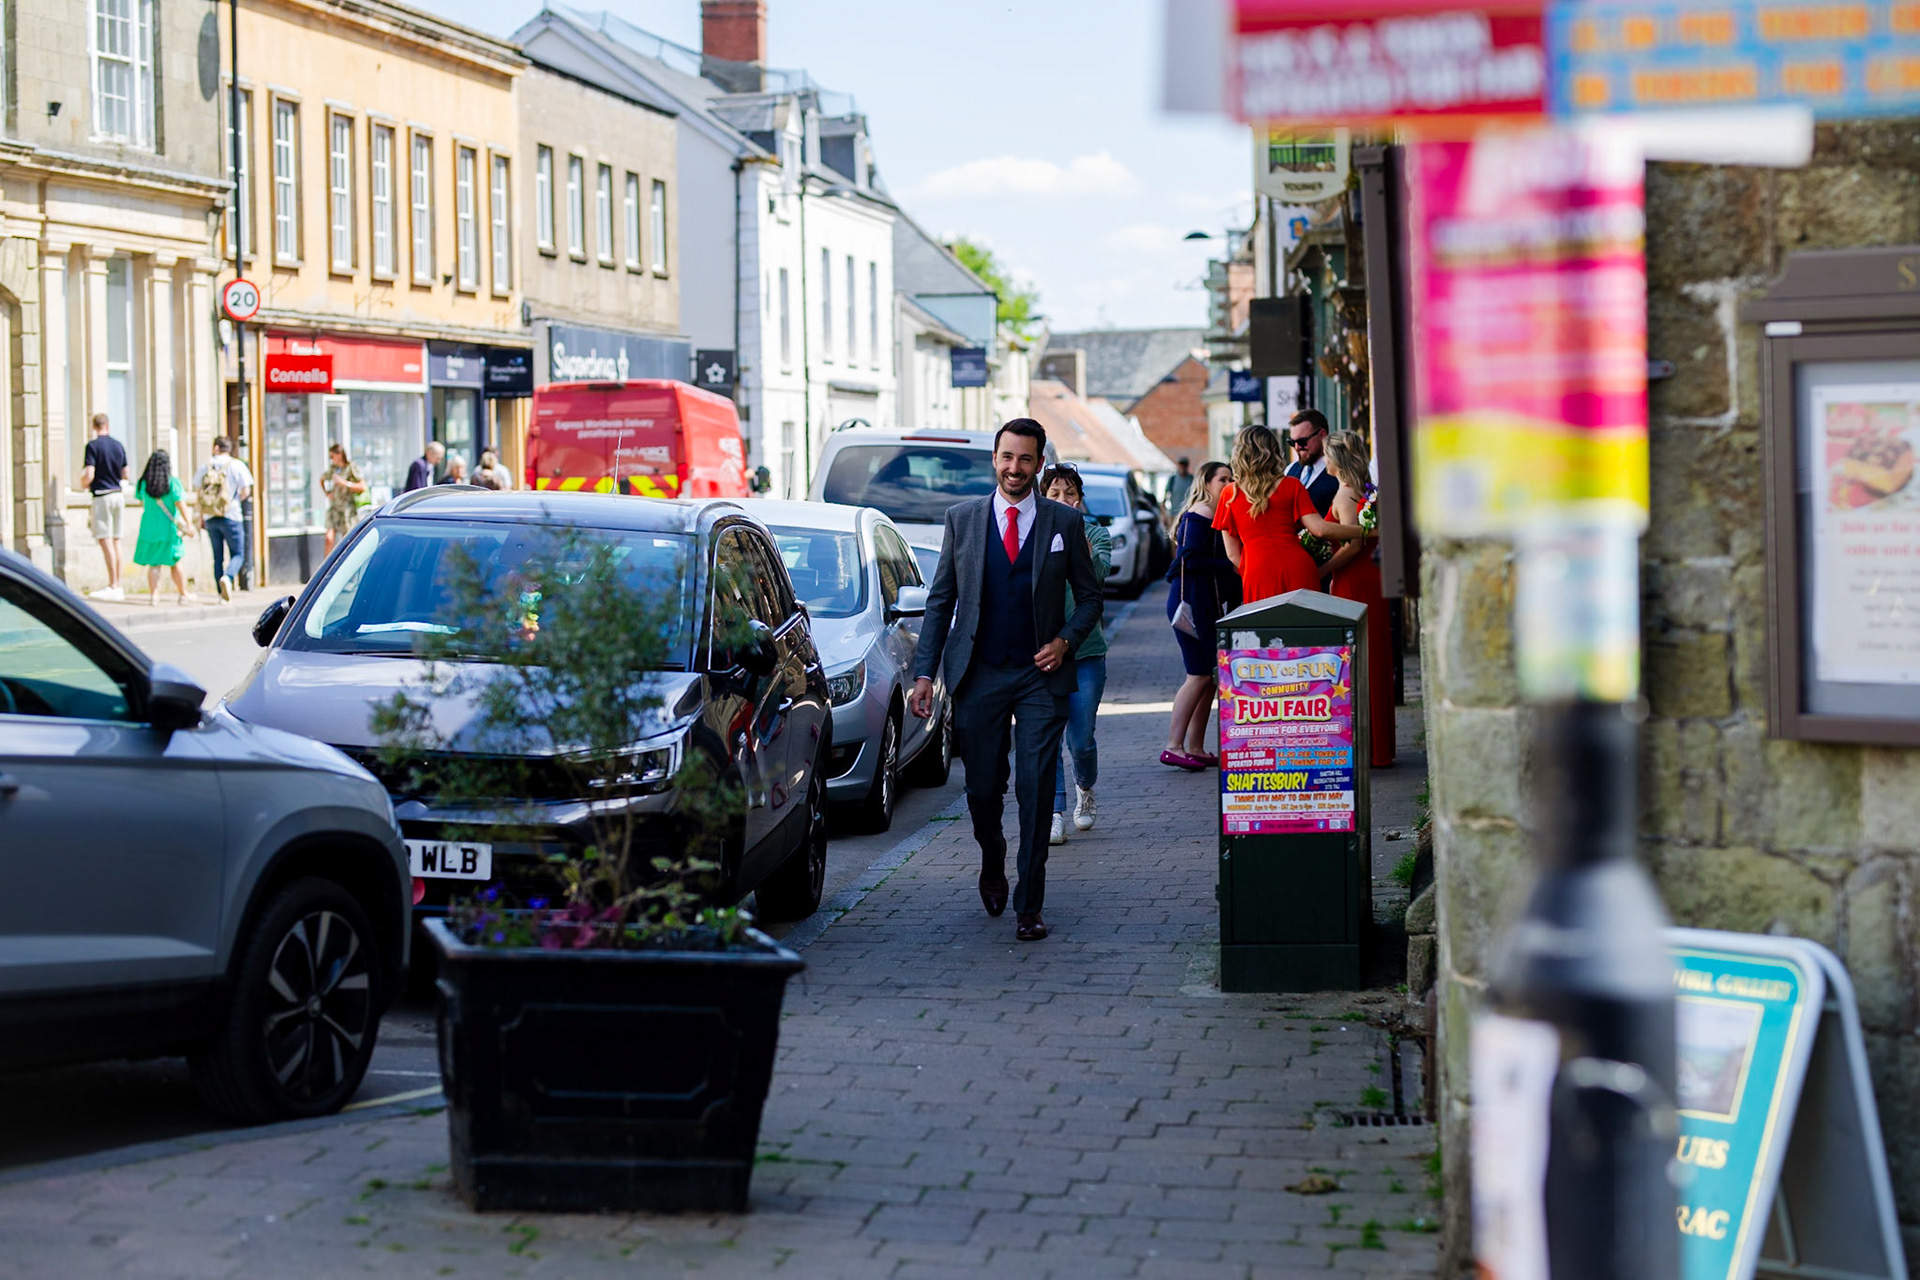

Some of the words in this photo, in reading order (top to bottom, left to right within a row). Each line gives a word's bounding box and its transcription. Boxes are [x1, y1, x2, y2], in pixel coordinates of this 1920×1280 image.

[231, 291, 256, 307] 20
[553, 342, 618, 381] Superdrug
[270, 368, 328, 384] Connells
[1237, 663, 1278, 679] CITY
[1281, 667, 1296, 676] OF
[1297, 662, 1337, 678] FUN
[1261, 682, 1309, 696] COMMUNITY
[1238, 699, 1278, 720] FUN
[1284, 698, 1327, 717] FAIR
[1229, 726, 1279, 737] SOMETHING
[1281, 725, 1298, 735] FOR
[1299, 724, 1340, 733] EVERYONE
[1227, 772, 1308, 791] SHAFTESBURY
[1271, 794, 1285, 802] MAY
[1328, 792, 1344, 800] MAY
[422, 845, 478, 874] WLB
[1676, 1135, 1730, 1169] UES
[1676, 1205, 1730, 1240] RAC
